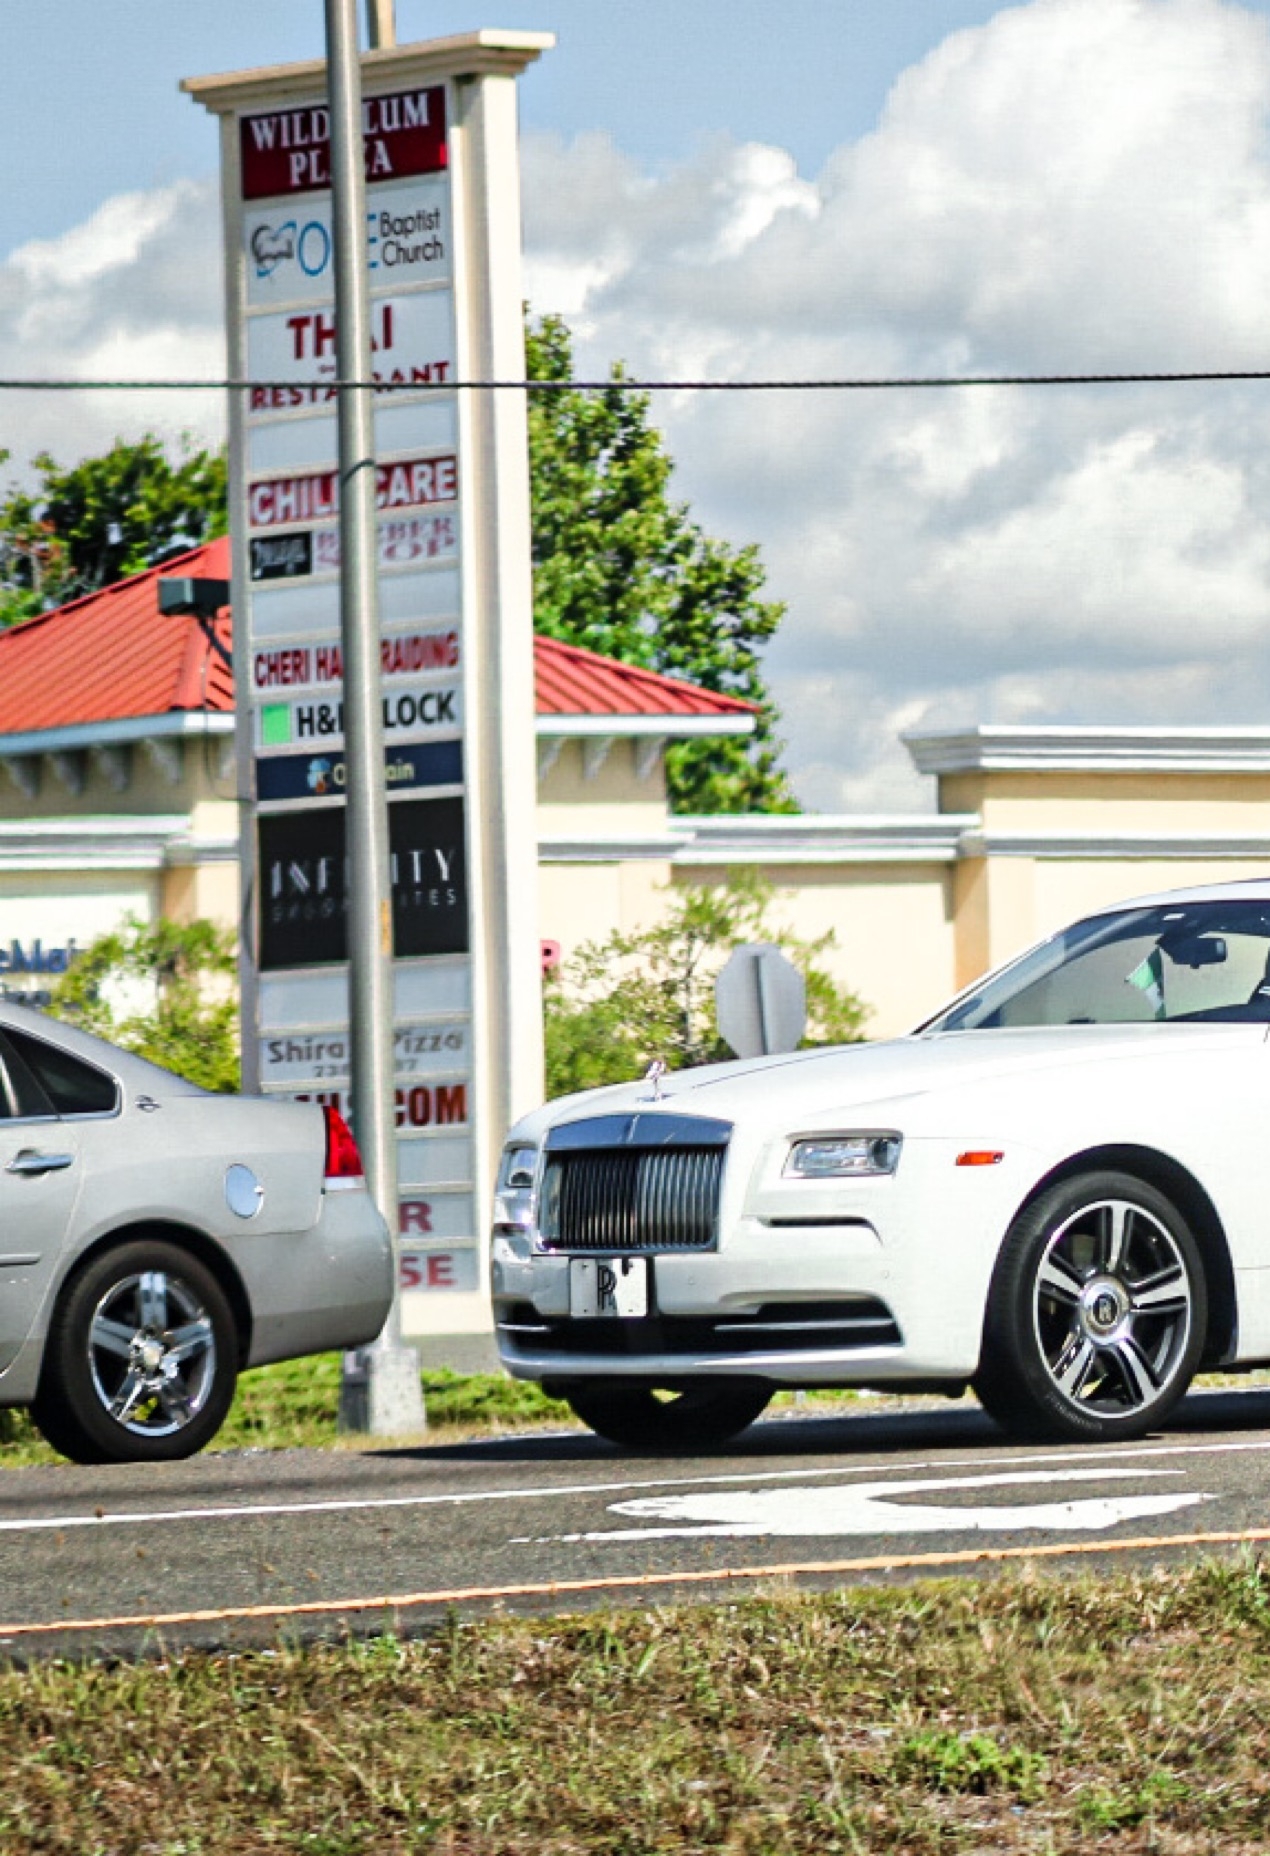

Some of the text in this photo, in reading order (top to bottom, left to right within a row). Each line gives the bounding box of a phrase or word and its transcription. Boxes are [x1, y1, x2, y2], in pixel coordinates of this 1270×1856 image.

[250, 92, 430, 151] WILD LUM
[289, 140, 393, 187] PLA
[379, 207, 441, 239] Baptist
[382, 234, 446, 267] Church
[286, 304, 393, 360] THI
[251, 360, 451, 410] RESTAANT
[254, 648, 313, 688] CHERI
[380, 631, 459, 675] RAIDING
[296, 689, 456, 738] H& LOCK
[271, 848, 456, 900] INFITY
[267, 1037, 344, 1065] Shira
